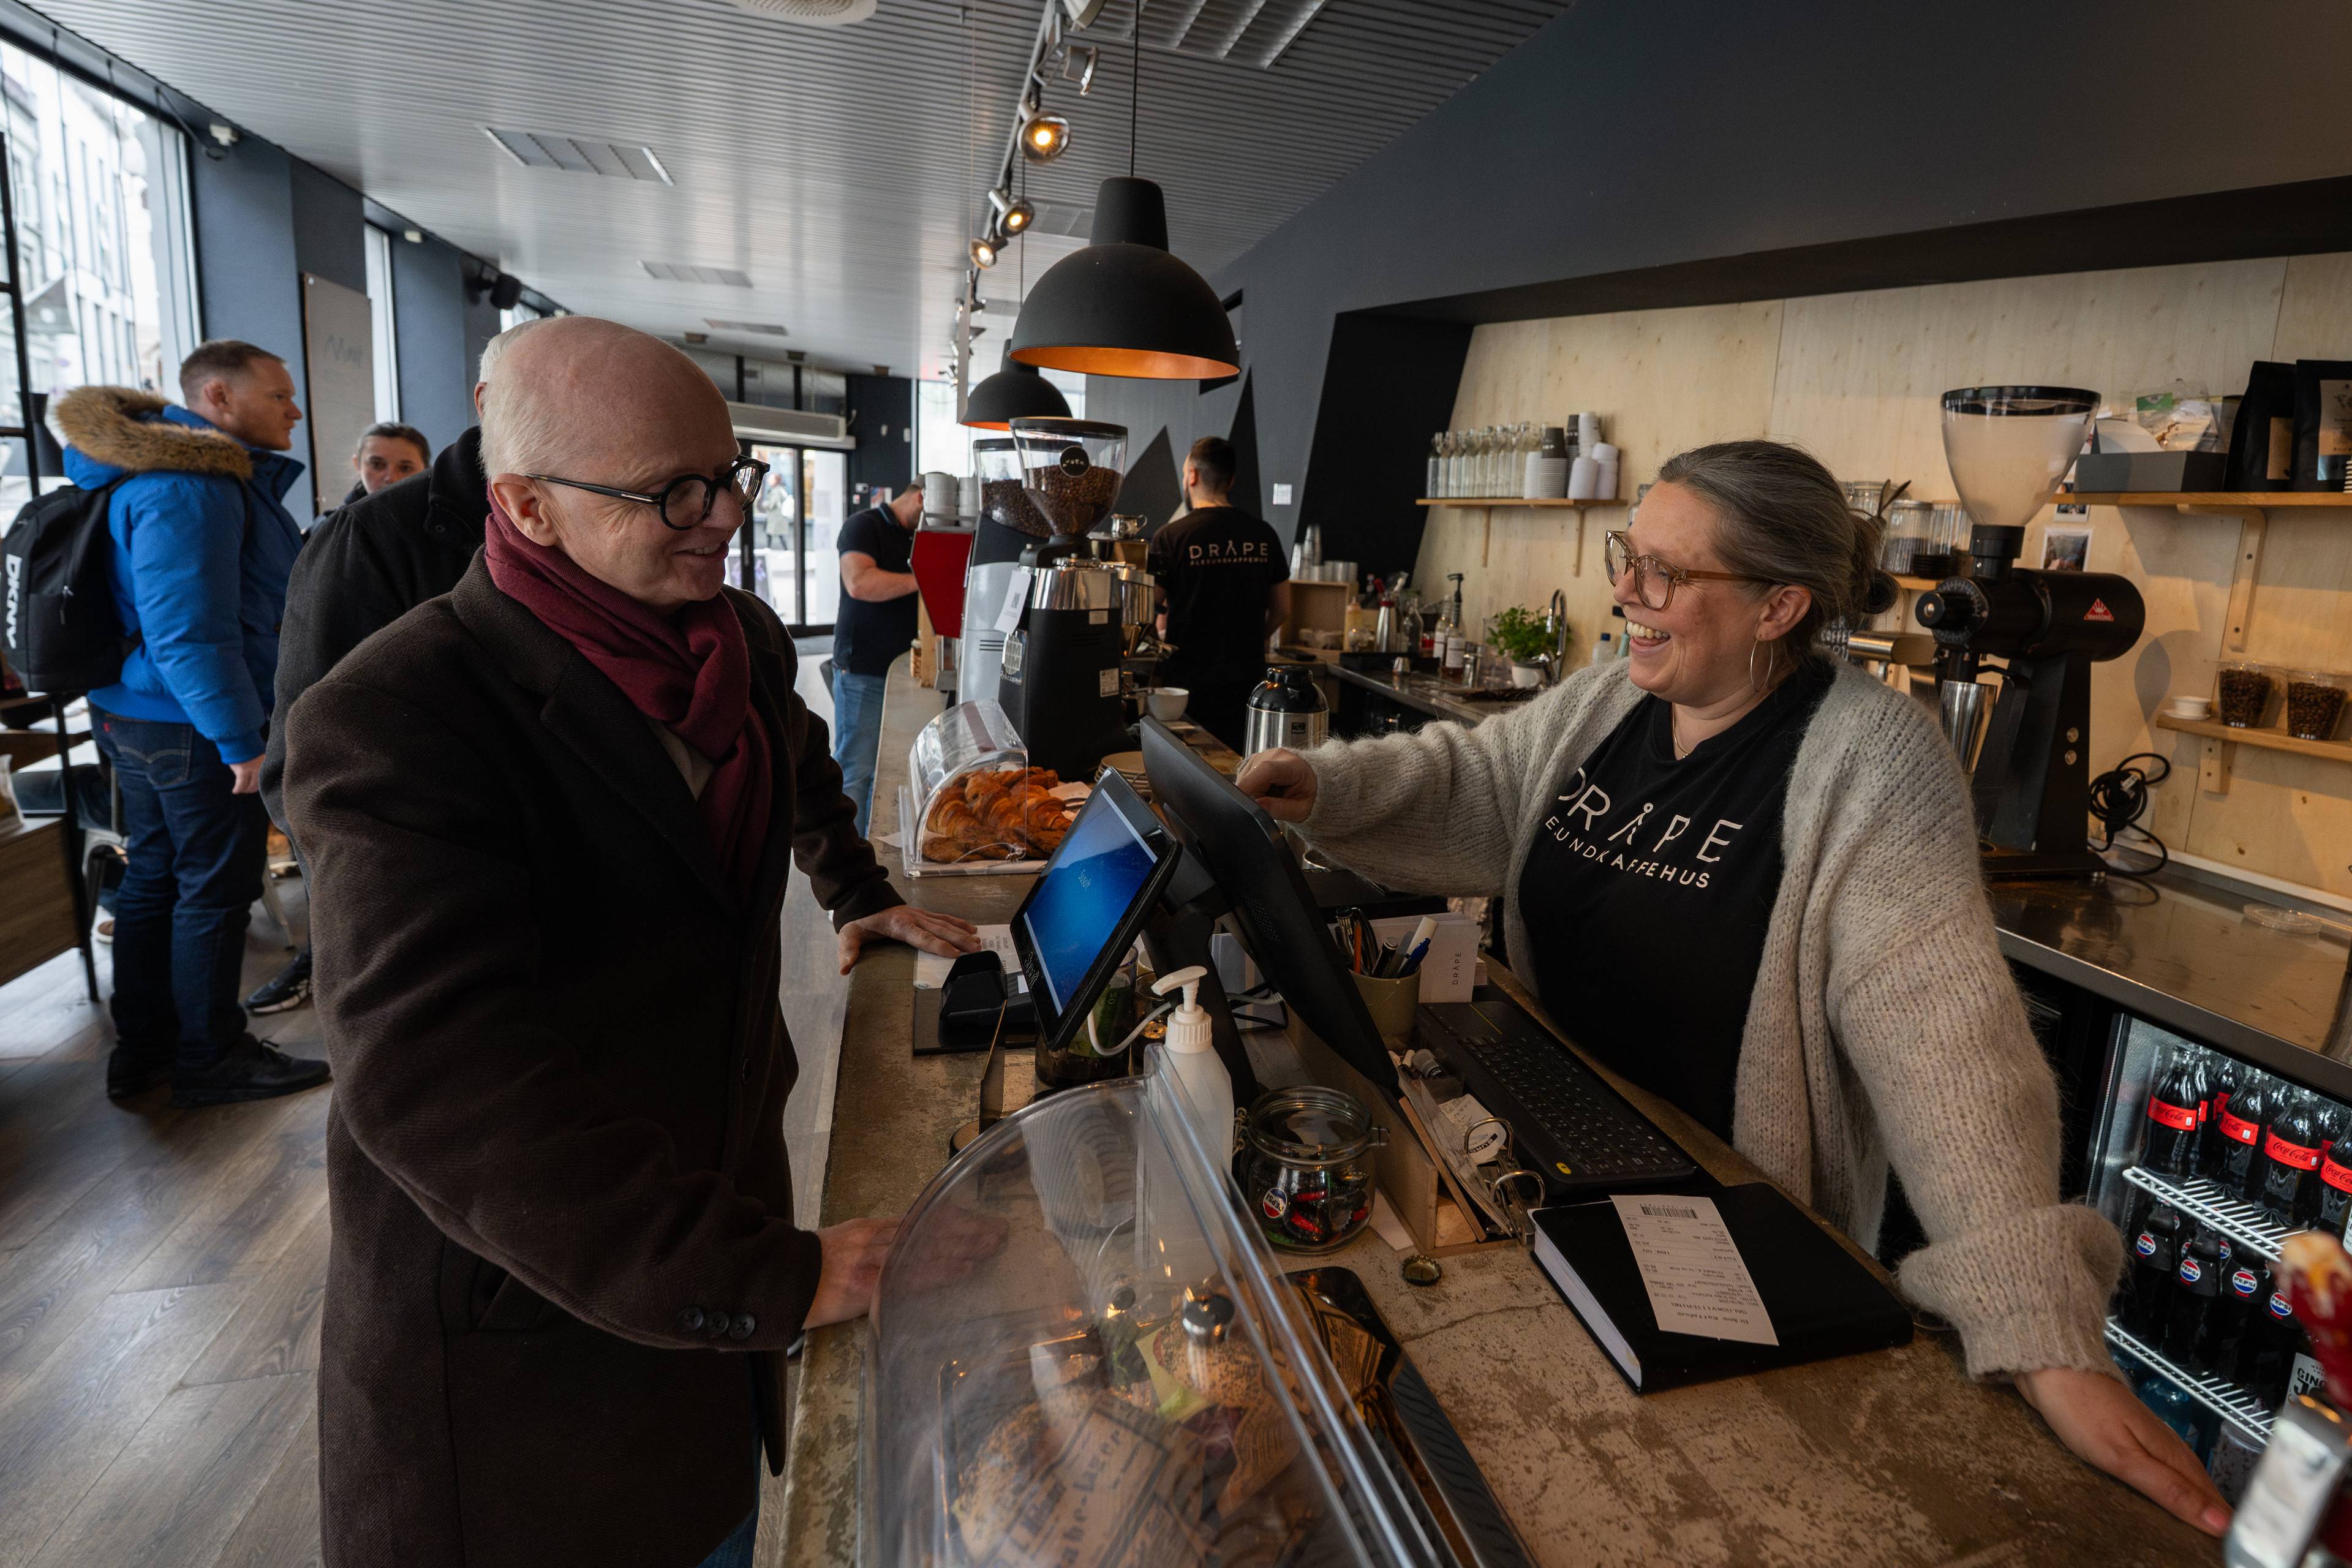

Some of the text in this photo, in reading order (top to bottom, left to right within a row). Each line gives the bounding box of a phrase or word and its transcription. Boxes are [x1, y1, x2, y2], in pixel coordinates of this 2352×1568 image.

[1189, 540, 1268, 559] DRÅPE
[6, 554, 22, 649] DKNY
[1108, 991, 1117, 1005] 50
[2273, 1141, 2311, 1162] Coca-Cola
[2138, 1238, 2154, 1251] PEPSI
[2181, 1264, 2199, 1277] PEPSI
[2234, 1276, 2256, 1287] PEPSI
[2272, 1297, 2291, 1311] PEPSI
